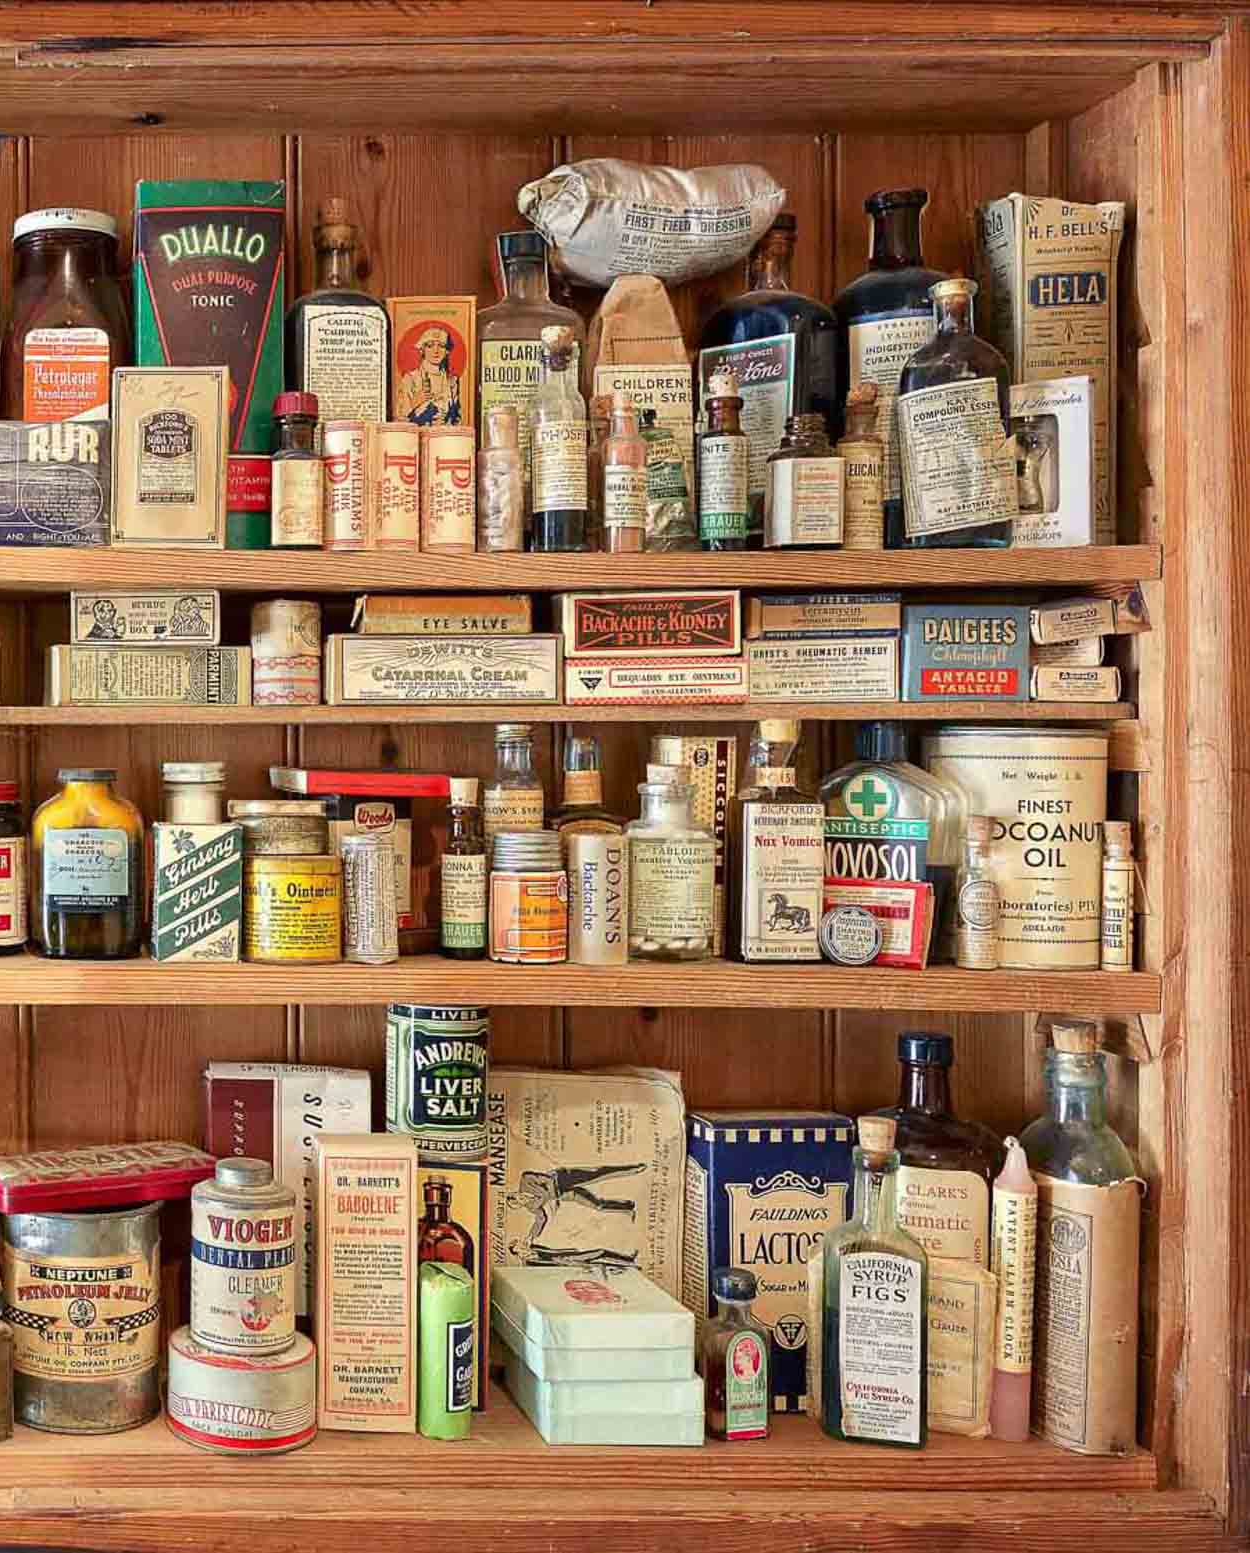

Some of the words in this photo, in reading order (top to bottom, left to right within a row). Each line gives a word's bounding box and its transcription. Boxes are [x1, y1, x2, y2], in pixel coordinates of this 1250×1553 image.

[625, 214, 653, 229] FIRST
[662, 219, 691, 231] FIELD
[1029, 227, 1042, 239] H.
[1062, 222, 1108, 236] BELL'S
[158, 223, 265, 263] DUALLO
[1038, 277, 1101, 303] HELA
[190, 294, 235, 309] TONIC
[484, 368, 521, 382] BLOOD
[913, 404, 966, 423] COMPOUND
[6, 531, 26, 541] AND
[422, 618, 448, 630] EYE
[461, 617, 509, 630] SALVE
[581, 611, 655, 633] BACKACHE
[669, 609, 726, 630] KIDNEY
[616, 632, 692, 646] PILLS
[922, 618, 1017, 646] PAIGEES
[207, 649, 221, 701] PARMINT
[470, 663, 528, 682] CREAM
[668, 673, 687, 682] EYE
[931, 672, 1008, 683] ANTACID
[939, 683, 1002, 693] TABLETS
[1018, 800, 1072, 814] FINEST
[822, 821, 920, 836] ANTISEPTIC
[164, 834, 237, 885] Ginseng
[1024, 848, 1066, 868] OIL
[174, 875, 221, 914] Herb
[582, 862, 598, 931] Backache
[606, 848, 621, 944] DOAN'S
[174, 908, 223, 947] Pills
[431, 1010, 479, 1021] LIVER
[415, 1041, 486, 1068] ANDREWS
[420, 1079, 483, 1095] LIVER
[427, 1099, 479, 1117] SALT
[490, 1092, 507, 1186] MANSEASE
[906, 1184, 968, 1199] CLARK'S
[750, 1206, 829, 1222] FAULDING'S
[45, 1267, 117, 1280] NEPTUNE
[847, 1259, 914, 1279] CALIFORNIA
[228, 1275, 283, 1294] CLEANER
[852, 1270, 907, 1285] SYRUP
[17, 1285, 111, 1301] PETROLEUM
[84, 1330, 125, 1342] WHITE
[333, 1365, 350, 1373] DR.
[354, 1366, 403, 1375] BARNETT
[338, 1376, 398, 1384] MANUFACTURING
